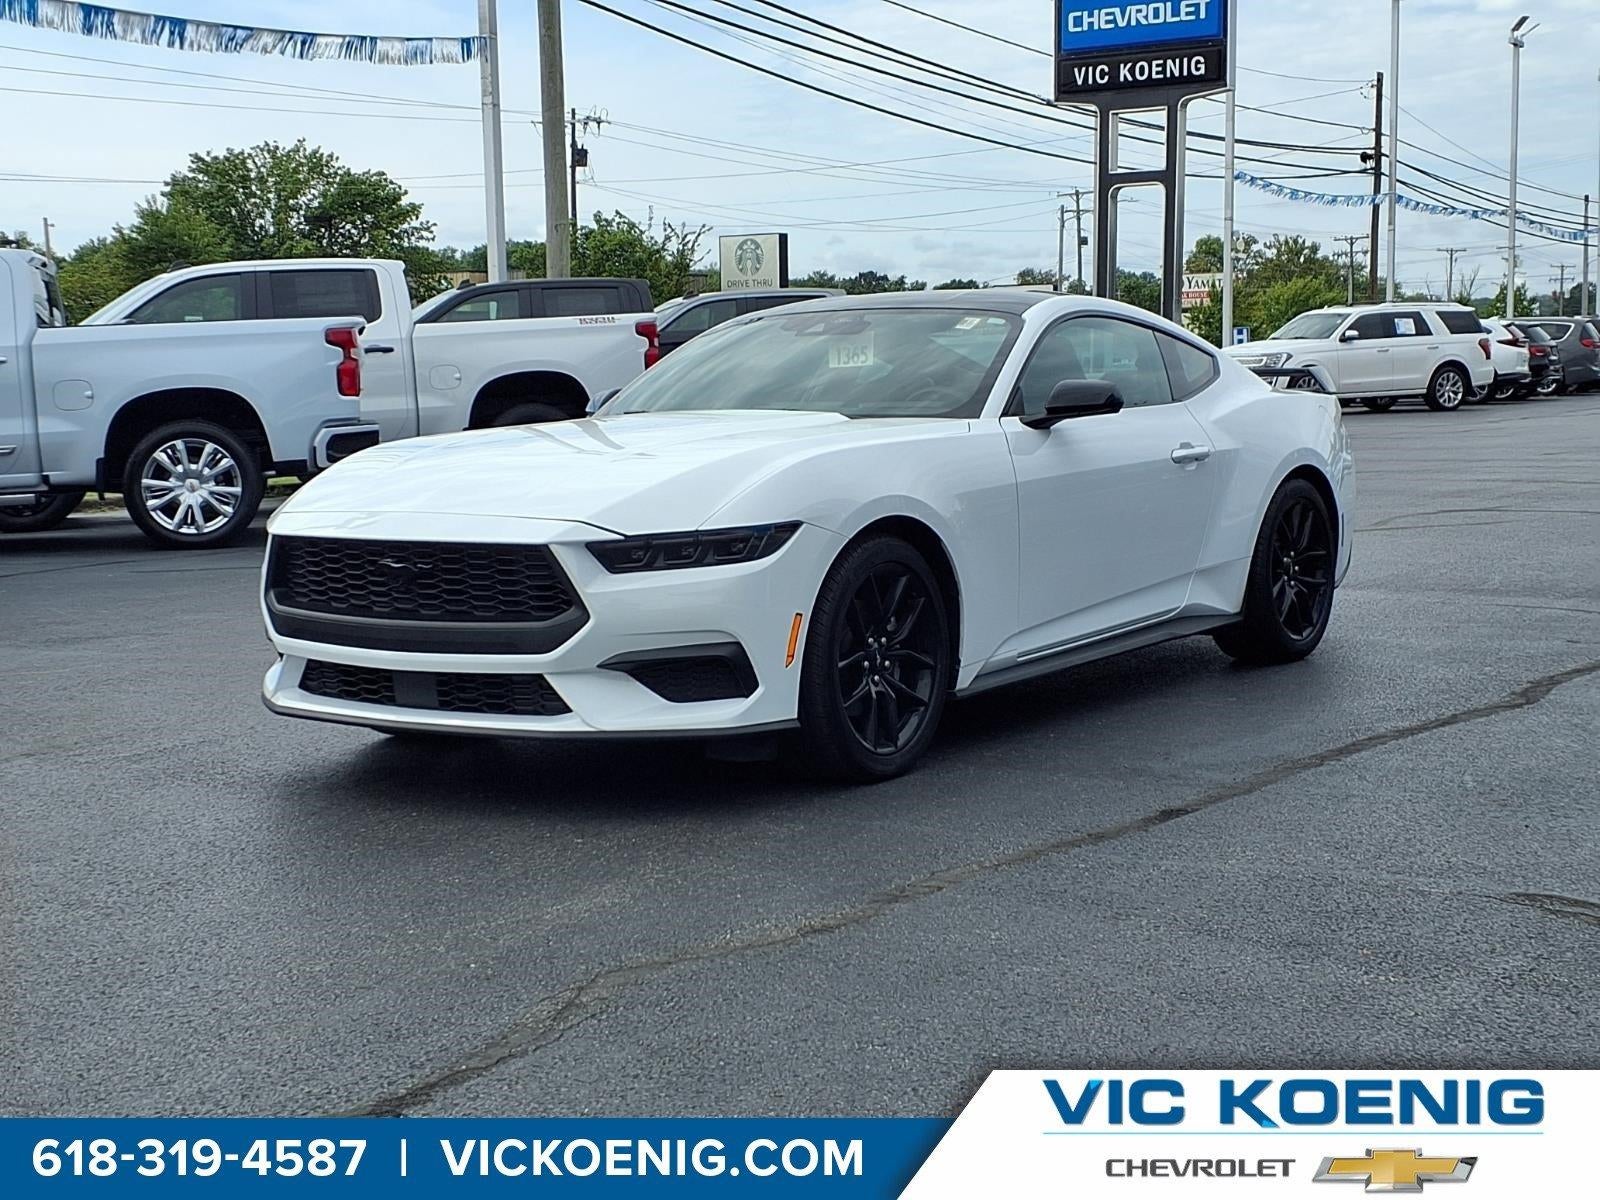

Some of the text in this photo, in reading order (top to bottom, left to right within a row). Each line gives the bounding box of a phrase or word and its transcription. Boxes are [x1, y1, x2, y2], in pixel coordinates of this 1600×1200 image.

[1067, 0, 1210, 33] CHEVROLET
[1074, 55, 1206, 86] VIC KOENIG
[726, 278, 773, 288] DRIVE THRU
[837, 345, 868, 365] 1365
